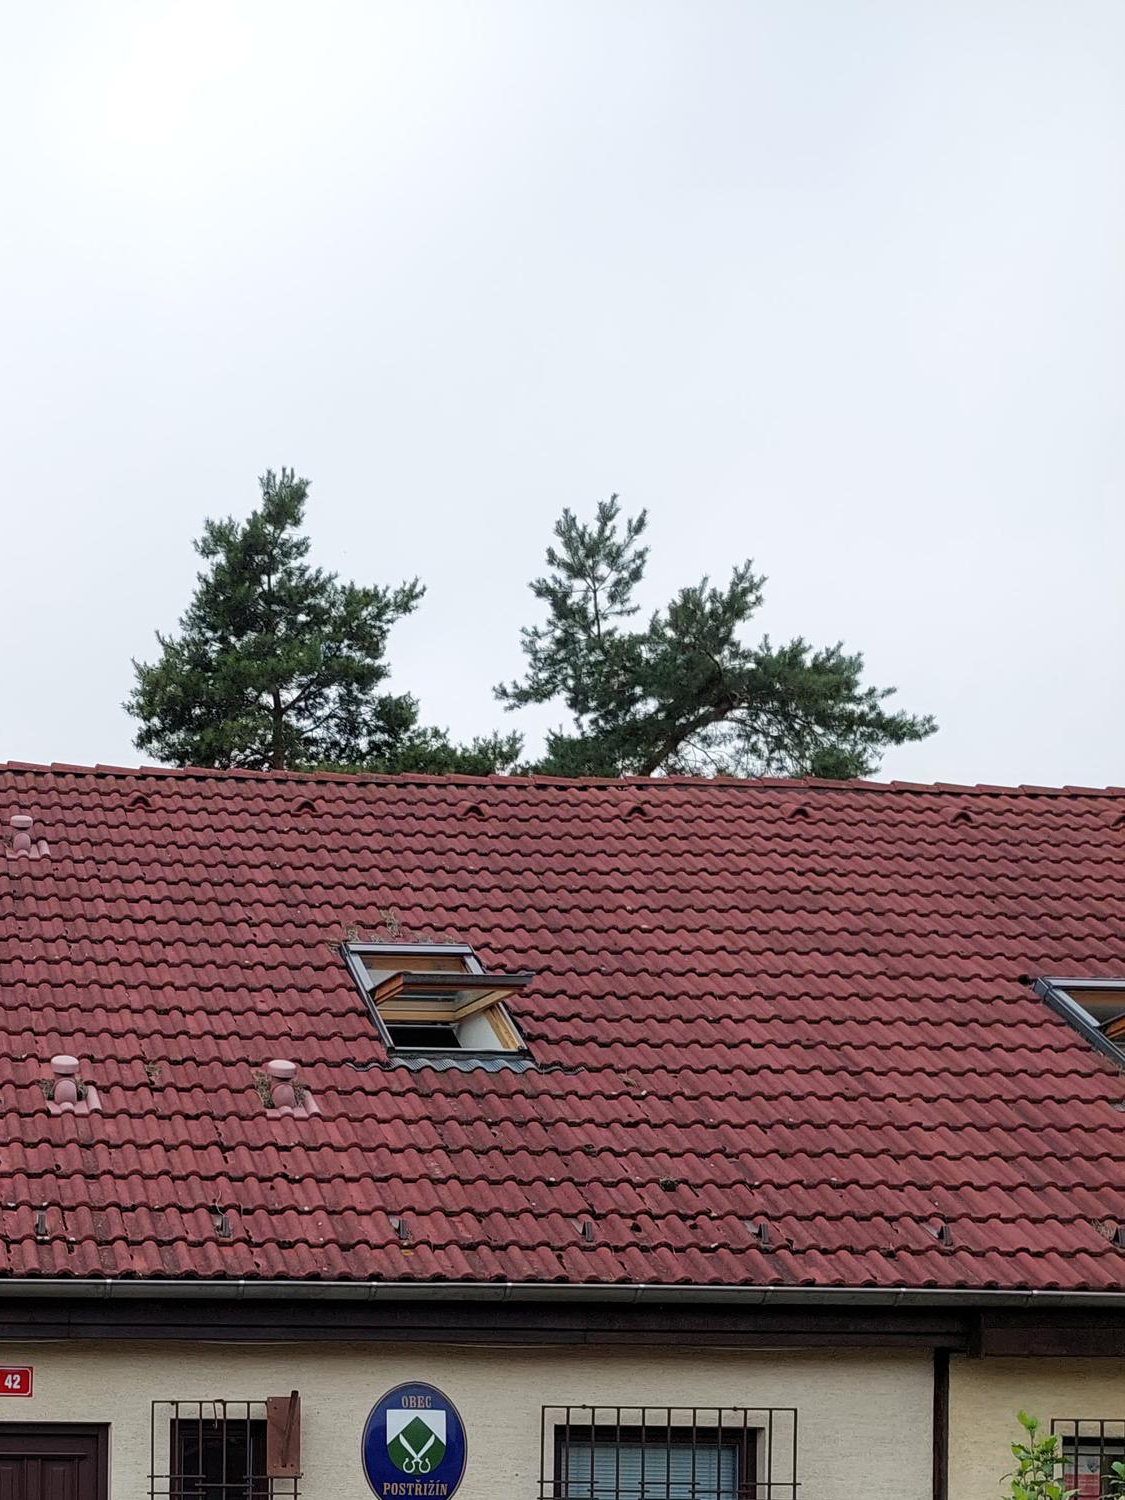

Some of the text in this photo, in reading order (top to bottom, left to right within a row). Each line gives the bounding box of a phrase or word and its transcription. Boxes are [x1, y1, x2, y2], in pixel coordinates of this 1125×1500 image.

[4, 1374, 21, 1389] 42
[401, 1395, 432, 1409] OBEC
[383, 1479, 448, 1496] POSTŘIŽÍN
